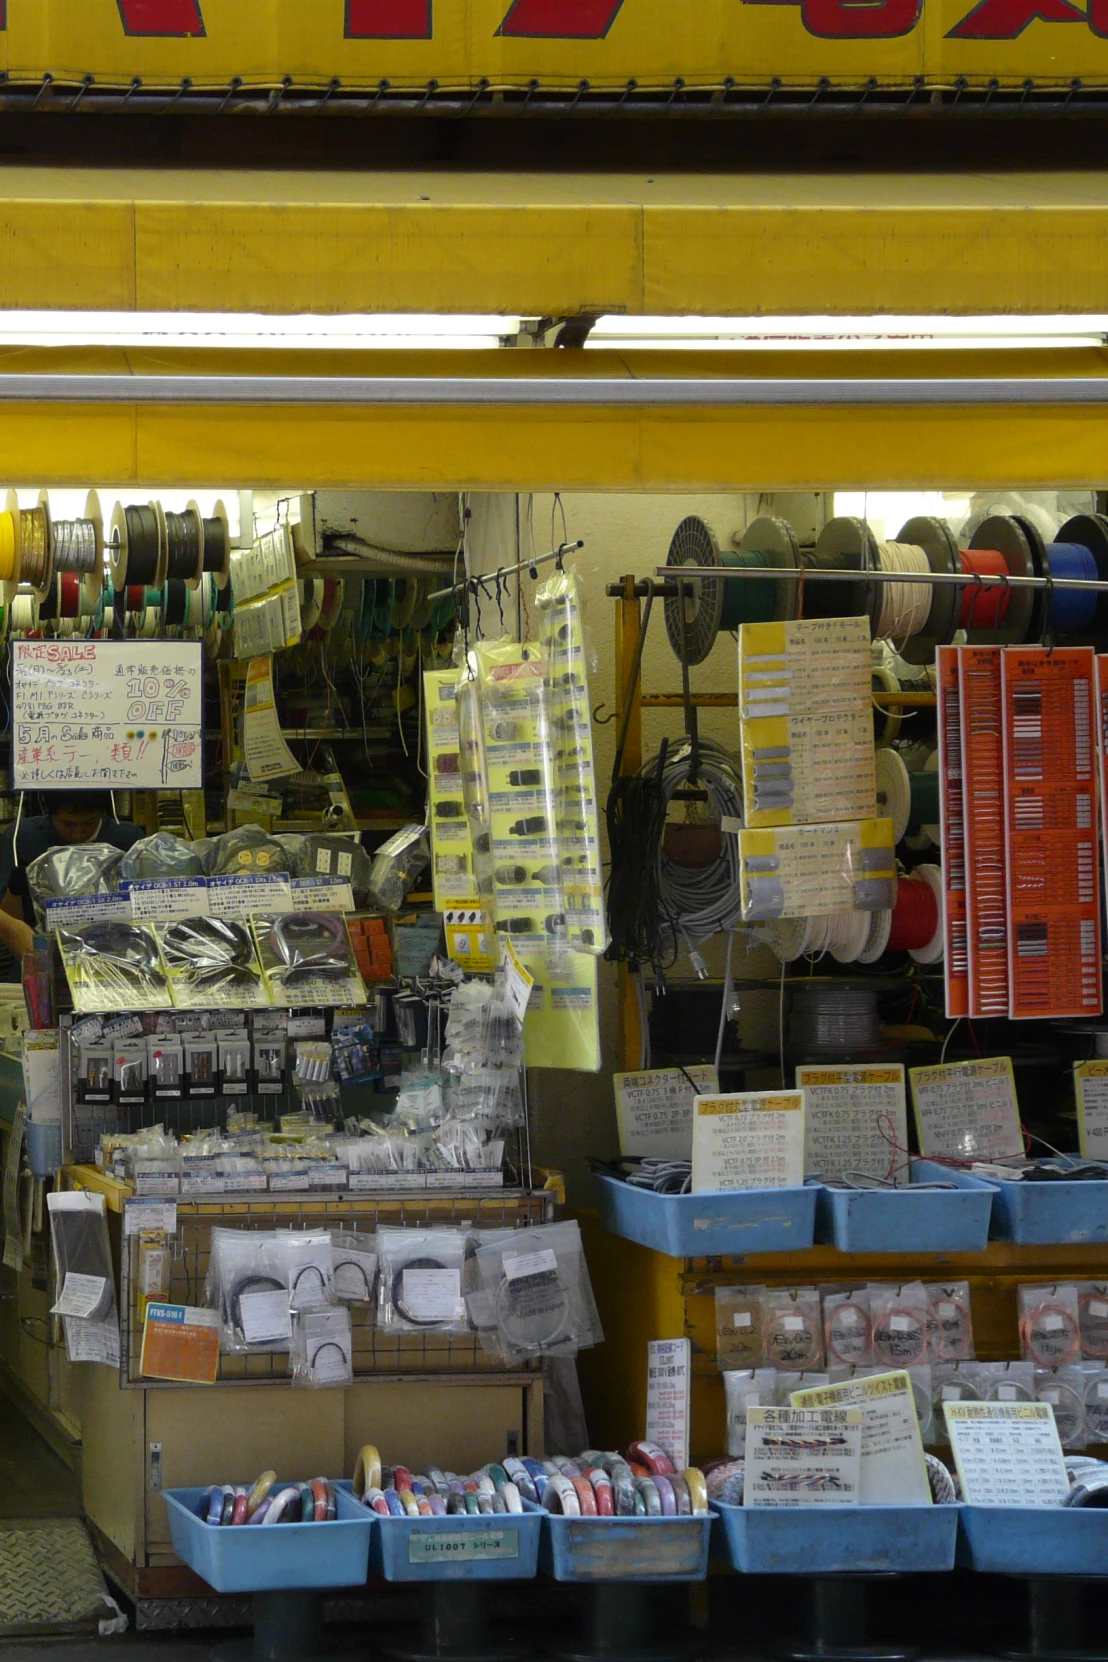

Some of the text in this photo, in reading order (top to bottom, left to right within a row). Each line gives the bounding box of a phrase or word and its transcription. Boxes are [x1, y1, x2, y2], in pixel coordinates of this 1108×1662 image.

[126, 677, 191, 699] 10%
[127, 700, 184, 721] OFF
[627, 1090, 644, 1098] VCTF
[852, 1086, 882, 1094] プラグ付
[749, 1134, 775, 1142] プラグ付
[763, 1409, 848, 1423] 各種加工電線
[425, 1543, 466, 1551] UL1007
